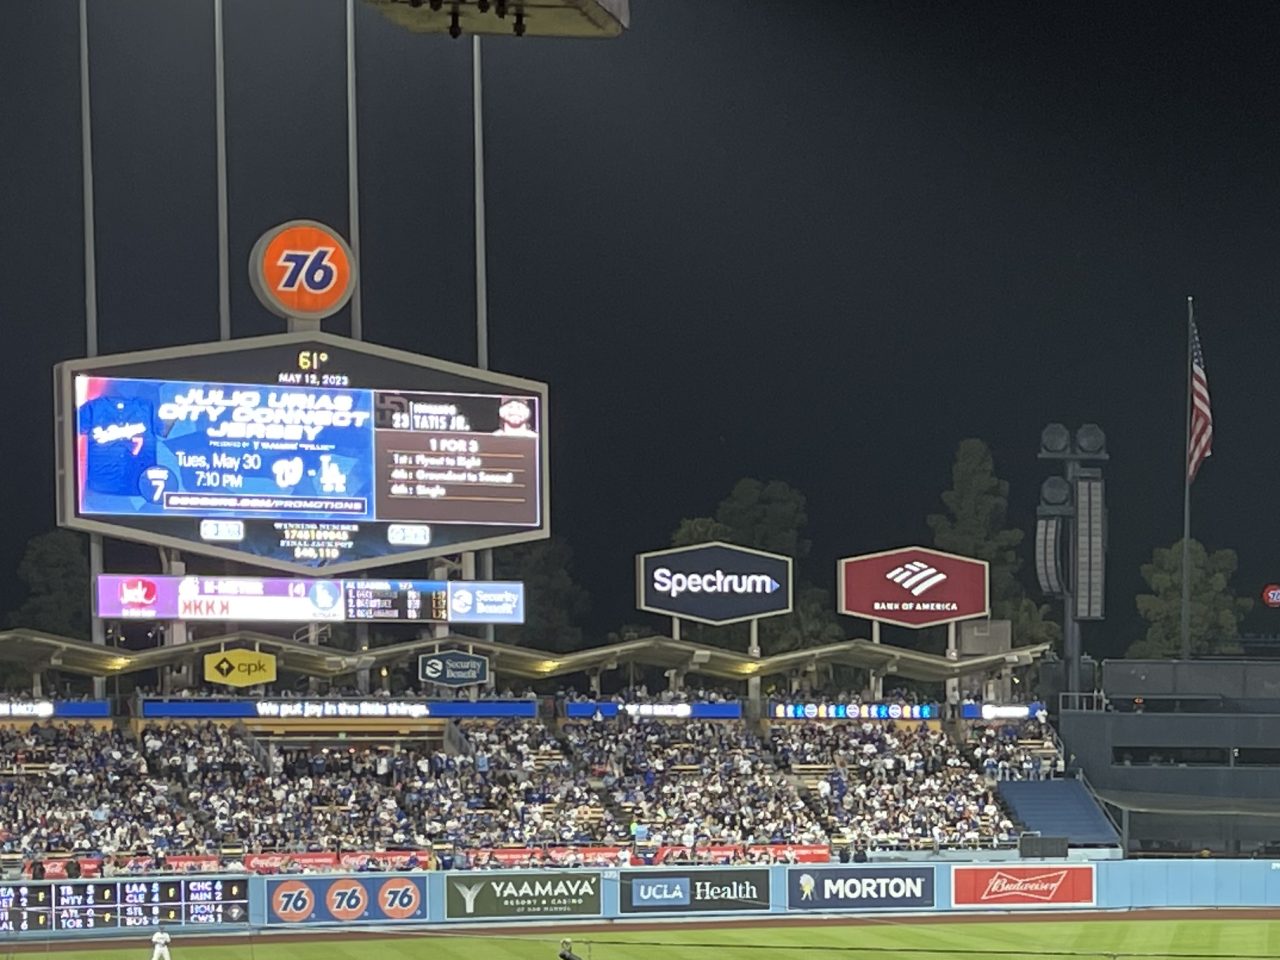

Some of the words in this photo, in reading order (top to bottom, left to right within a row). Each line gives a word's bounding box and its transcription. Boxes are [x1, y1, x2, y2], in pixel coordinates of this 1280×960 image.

[278, 248, 337, 293] 76
[279, 374, 303, 385] MAY
[307, 374, 321, 387] 12,
[323, 375, 349, 386] 2023
[414, 415, 447, 429] TATIS
[131, 437, 144, 456] 7
[440, 439, 467, 452] FOR
[176, 452, 209, 469] Tues,
[213, 453, 241, 470] May
[243, 454, 262, 469] 30
[196, 471, 219, 486] 7:10
[222, 474, 243, 487] PM
[151, 480, 166, 500] 7
[653, 567, 771, 597] Spectrum
[476, 591, 518, 608] Security
[874, 602, 899, 611] BANK
[902, 602, 914, 611] OF
[916, 602, 958, 611] AMERICA
[237, 660, 267, 676] cpk
[446, 659, 482, 672] Security
[447, 669, 478, 679] Benefit
[257, 702, 279, 716] We
[304, 702, 323, 717] joy
[324, 702, 337, 716] in
[338, 703, 359, 716] the
[388, 702, 429, 717] things.
[61, 886, 73, 896] TB
[125, 883, 147, 894] LAA
[152, 882, 159, 892] 5
[189, 882, 212, 891] CHC
[215, 881, 222, 890] 6
[640, 884, 683, 900] UCLA
[695, 880, 758, 901] Health
[825, 878, 922, 900] MORTON
[992, 878, 1059, 893] Budweiser
[21, 897, 28, 906] 2
[126, 893, 145, 903] CLE
[152, 893, 159, 902] 4
[189, 892, 212, 901] MIN
[215, 891, 222, 900] 2
[281, 892, 309, 912] 76
[336, 890, 362, 911] 76
[387, 887, 414, 909] 76
[127, 906, 144, 916] STL
[61, 919, 83, 928] TOR
[87, 918, 93, 927] 3
[190, 914, 215, 923] CWS
